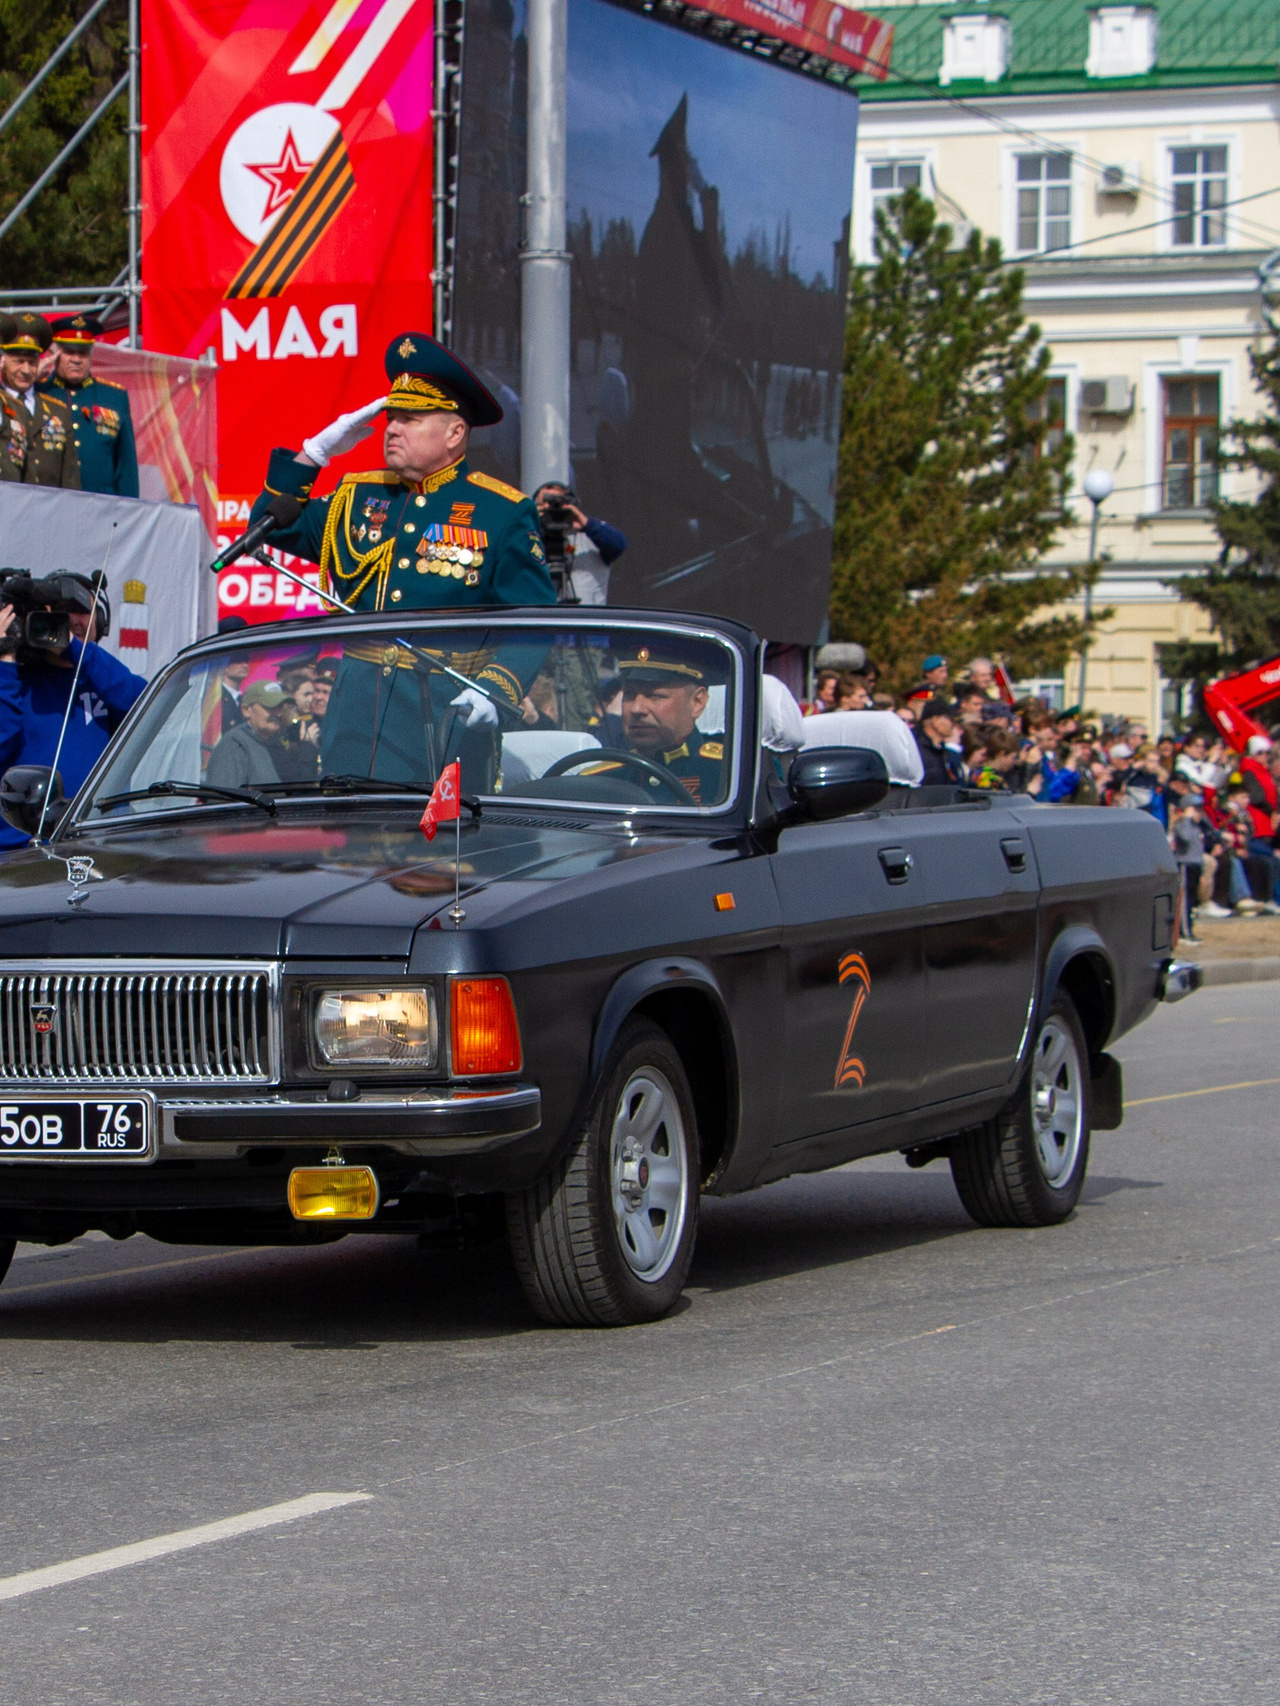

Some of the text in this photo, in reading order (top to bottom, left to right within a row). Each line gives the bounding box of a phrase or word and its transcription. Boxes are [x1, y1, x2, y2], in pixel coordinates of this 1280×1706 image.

[221, 304, 358, 361] МАЯ
[219, 573, 341, 612] ОБЕД
[97, 1104, 131, 1133] 76
[97, 1133, 127, 1148] RUS
